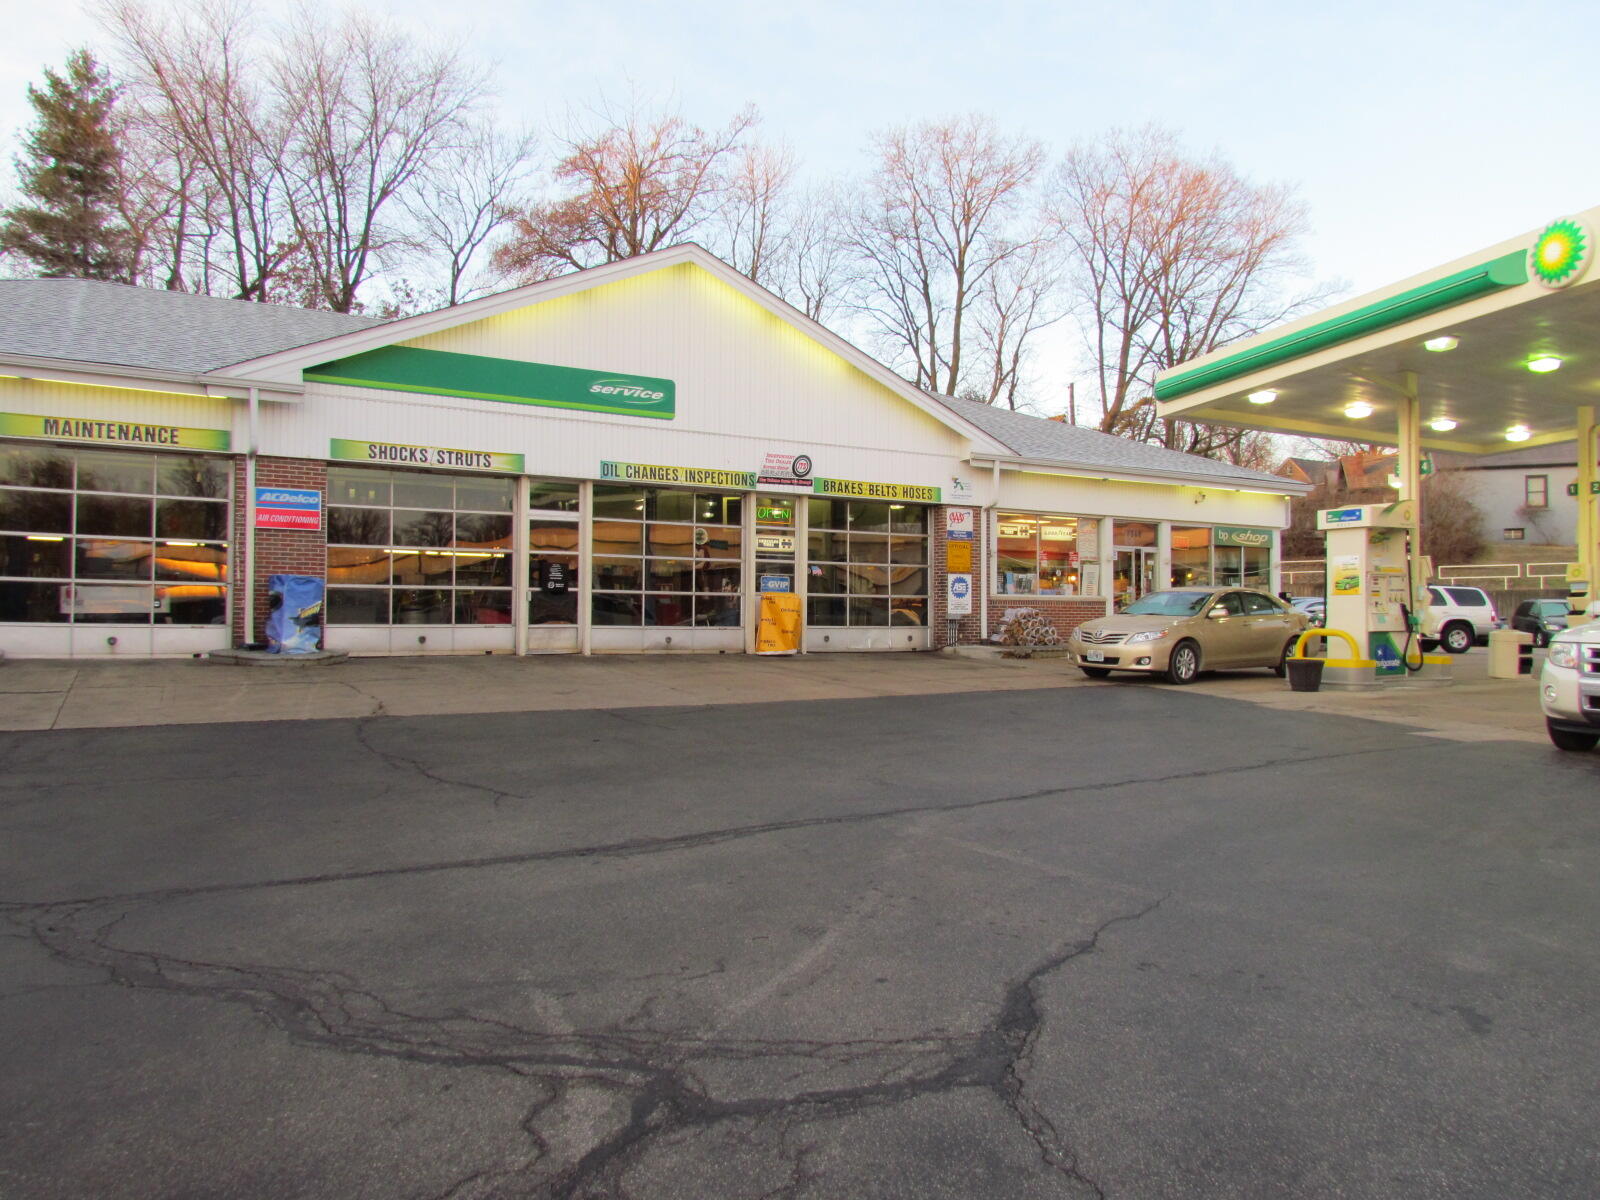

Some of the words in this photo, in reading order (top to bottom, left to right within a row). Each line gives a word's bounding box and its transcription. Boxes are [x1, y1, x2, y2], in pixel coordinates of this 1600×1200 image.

[589, 384, 664, 400] service
[44, 418, 179, 444] MAINTENANCE
[368, 444, 428, 463] SHOCKS
[437, 449, 492, 468] STRUTS
[602, 462, 620, 477] OIL
[625, 465, 679, 482] CHANGES
[685, 469, 755, 486] INSPECTIONS
[823, 480, 863, 495] BRAKES
[868, 484, 897, 498] BELTS
[902, 486, 933, 500] HOSES
[259, 492, 320, 504] ACDelco
[270, 515, 320, 525] CONDITIONING
[757, 507, 789, 519] OPEN
[1218, 529, 1229, 542] bp
[1239, 530, 1268, 544] shop
[952, 582, 967, 592] ASE
